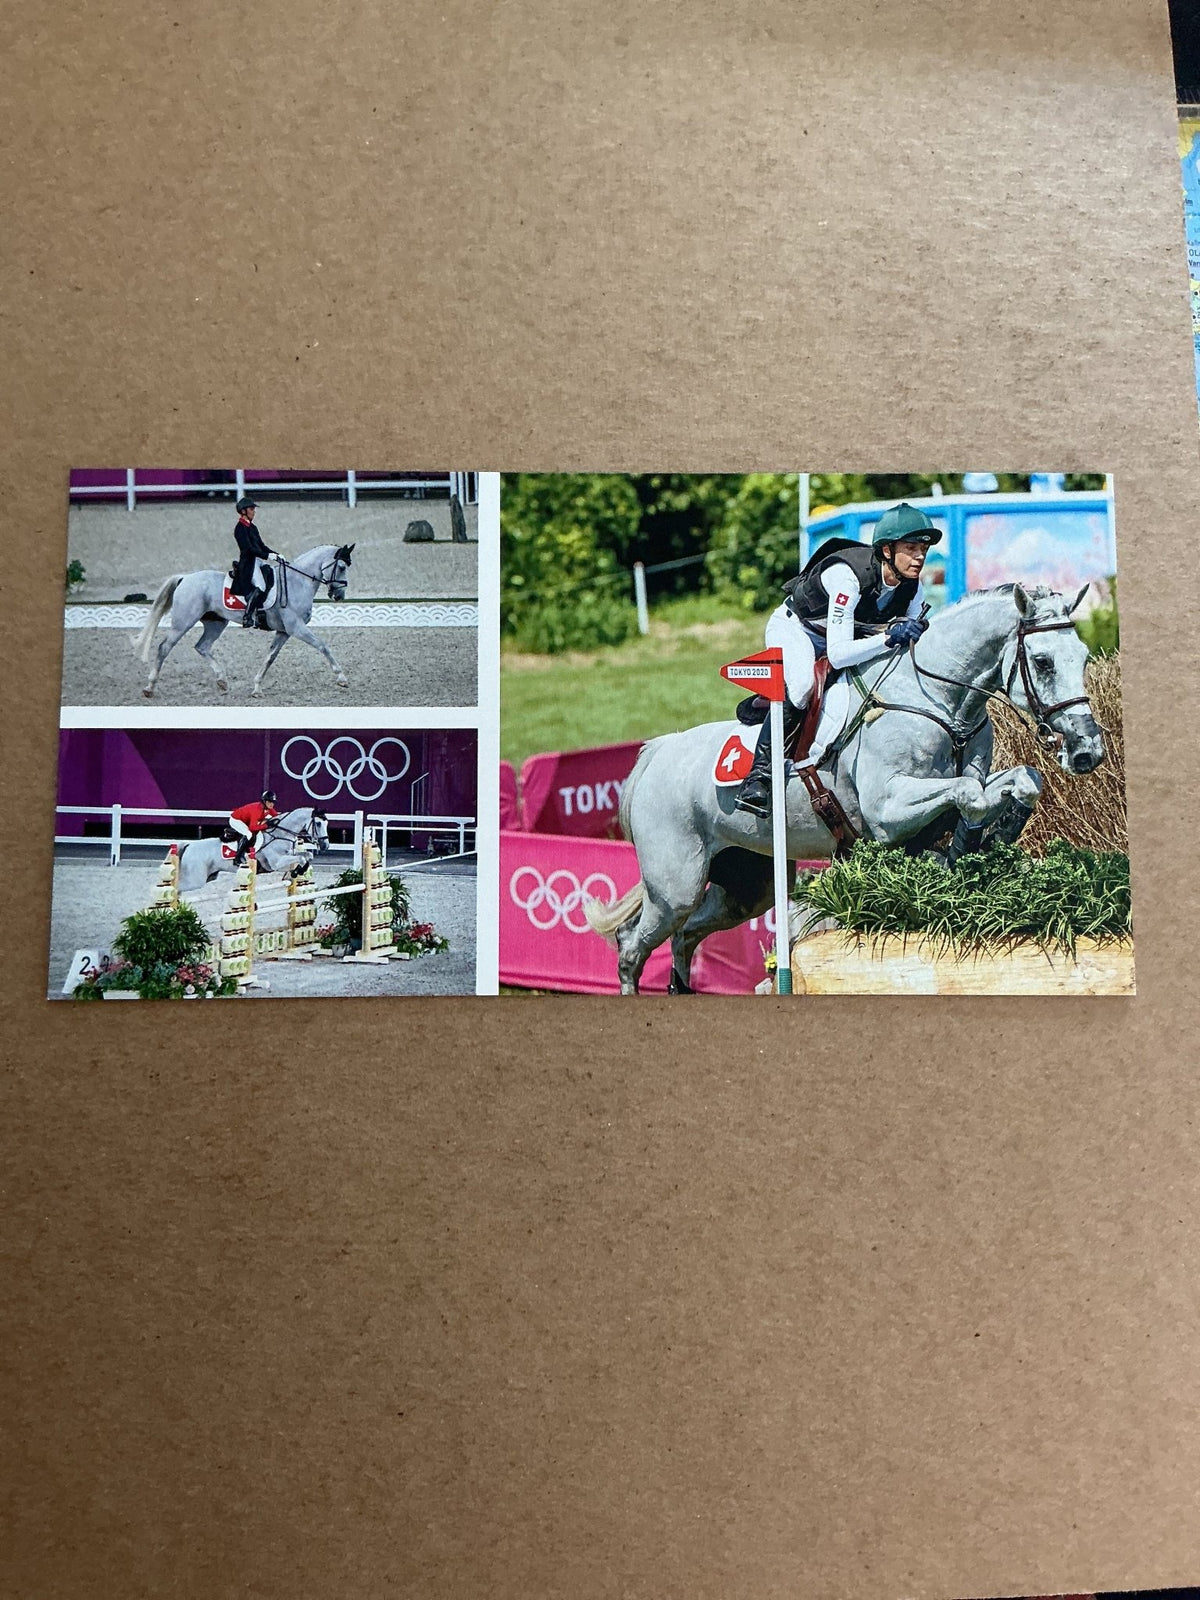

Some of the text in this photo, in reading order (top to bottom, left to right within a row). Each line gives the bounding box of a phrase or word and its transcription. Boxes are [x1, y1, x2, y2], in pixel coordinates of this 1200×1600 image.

[1188, 248, 1200, 257] OL
[831, 606, 845, 625] SUI
[730, 667, 769, 676] TOKYO 2020
[78, 955, 91, 975] 2
